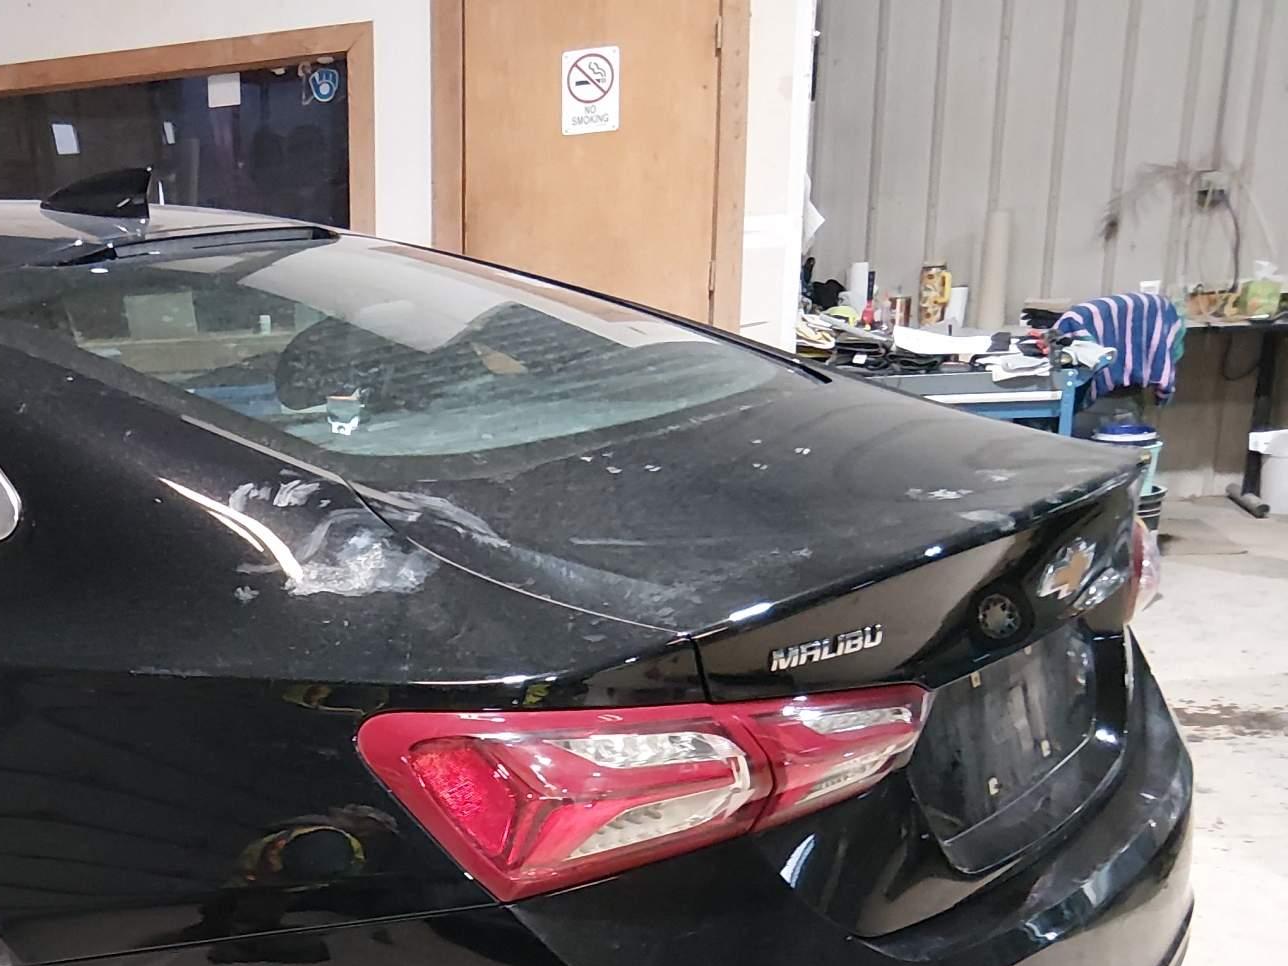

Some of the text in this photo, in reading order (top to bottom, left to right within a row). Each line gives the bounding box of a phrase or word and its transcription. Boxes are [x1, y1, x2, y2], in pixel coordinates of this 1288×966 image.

[584, 105, 596, 114] NO
[572, 113, 609, 126] SMOKING
[770, 624, 883, 672] MALIBU
